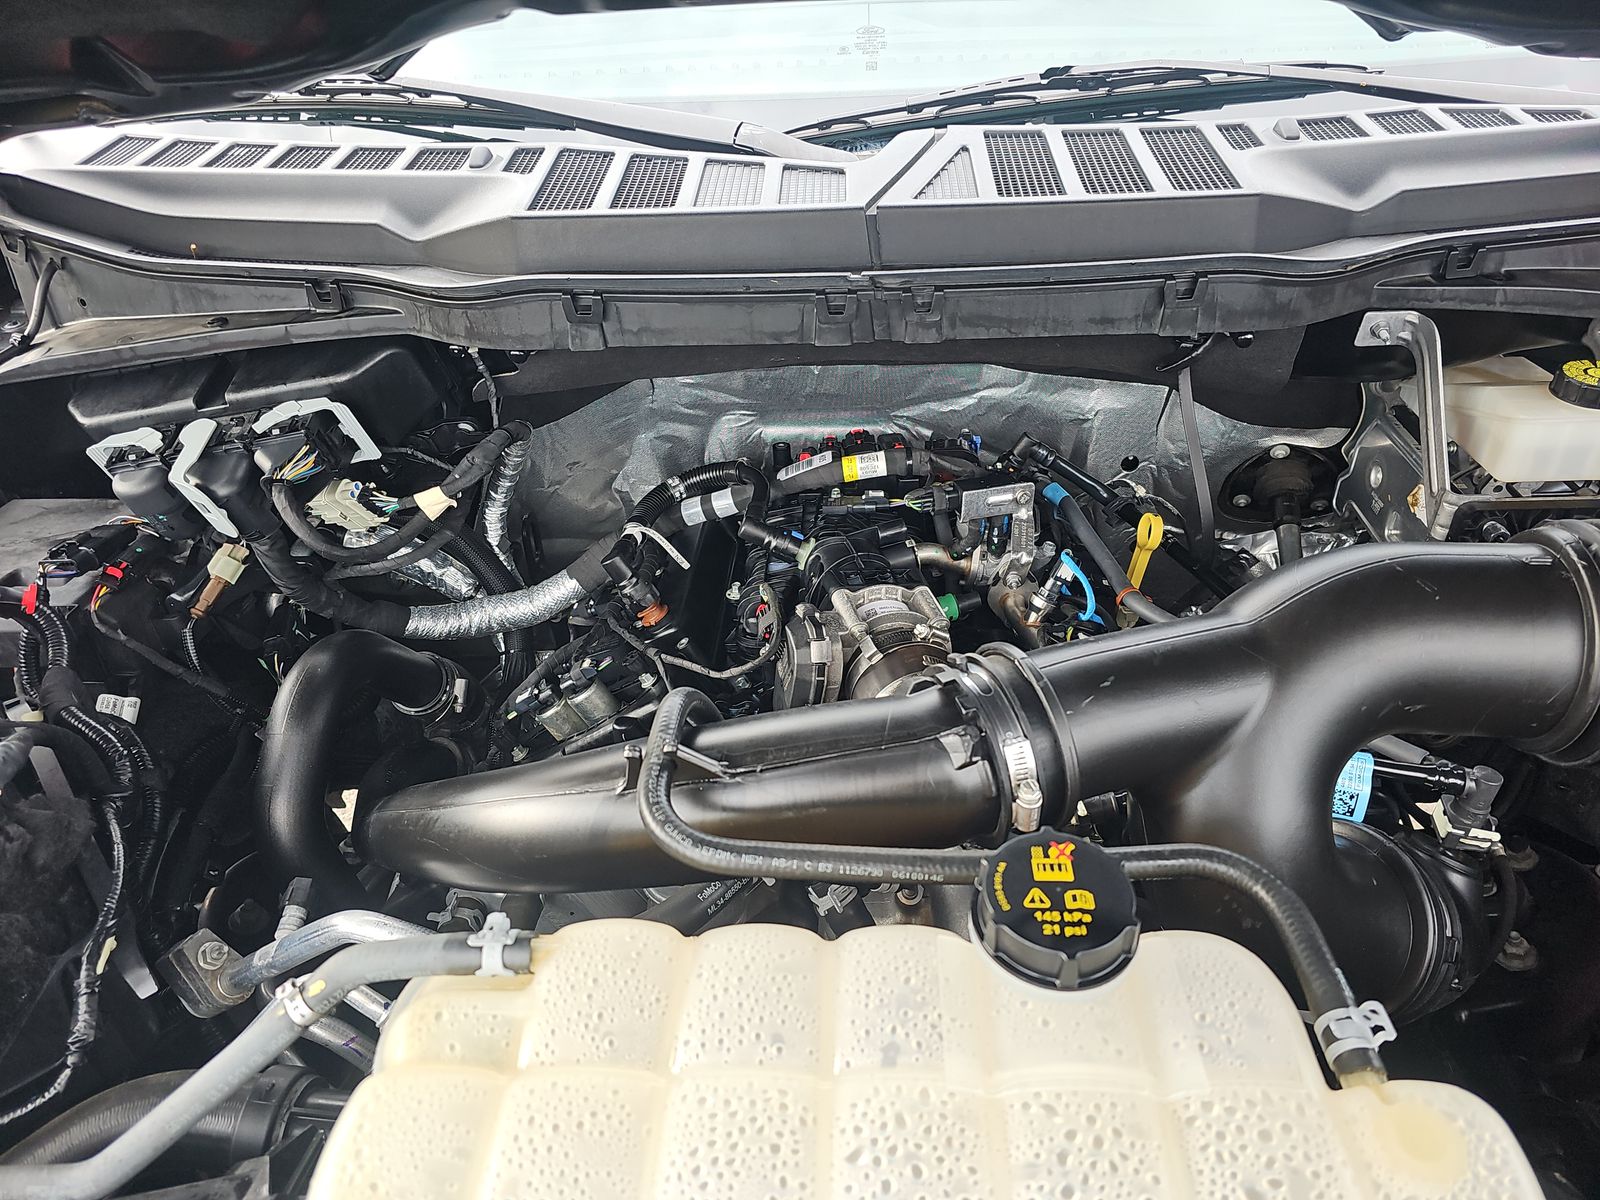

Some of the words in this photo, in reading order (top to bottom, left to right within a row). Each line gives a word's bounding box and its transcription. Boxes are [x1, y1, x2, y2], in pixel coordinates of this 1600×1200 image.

[697, 880, 721, 902] FoMoCo
[1034, 910, 1061, 922] 145
[1063, 910, 1093, 923] kPa
[1042, 924, 1061, 936] 21
[1063, 924, 1088, 938] psi
